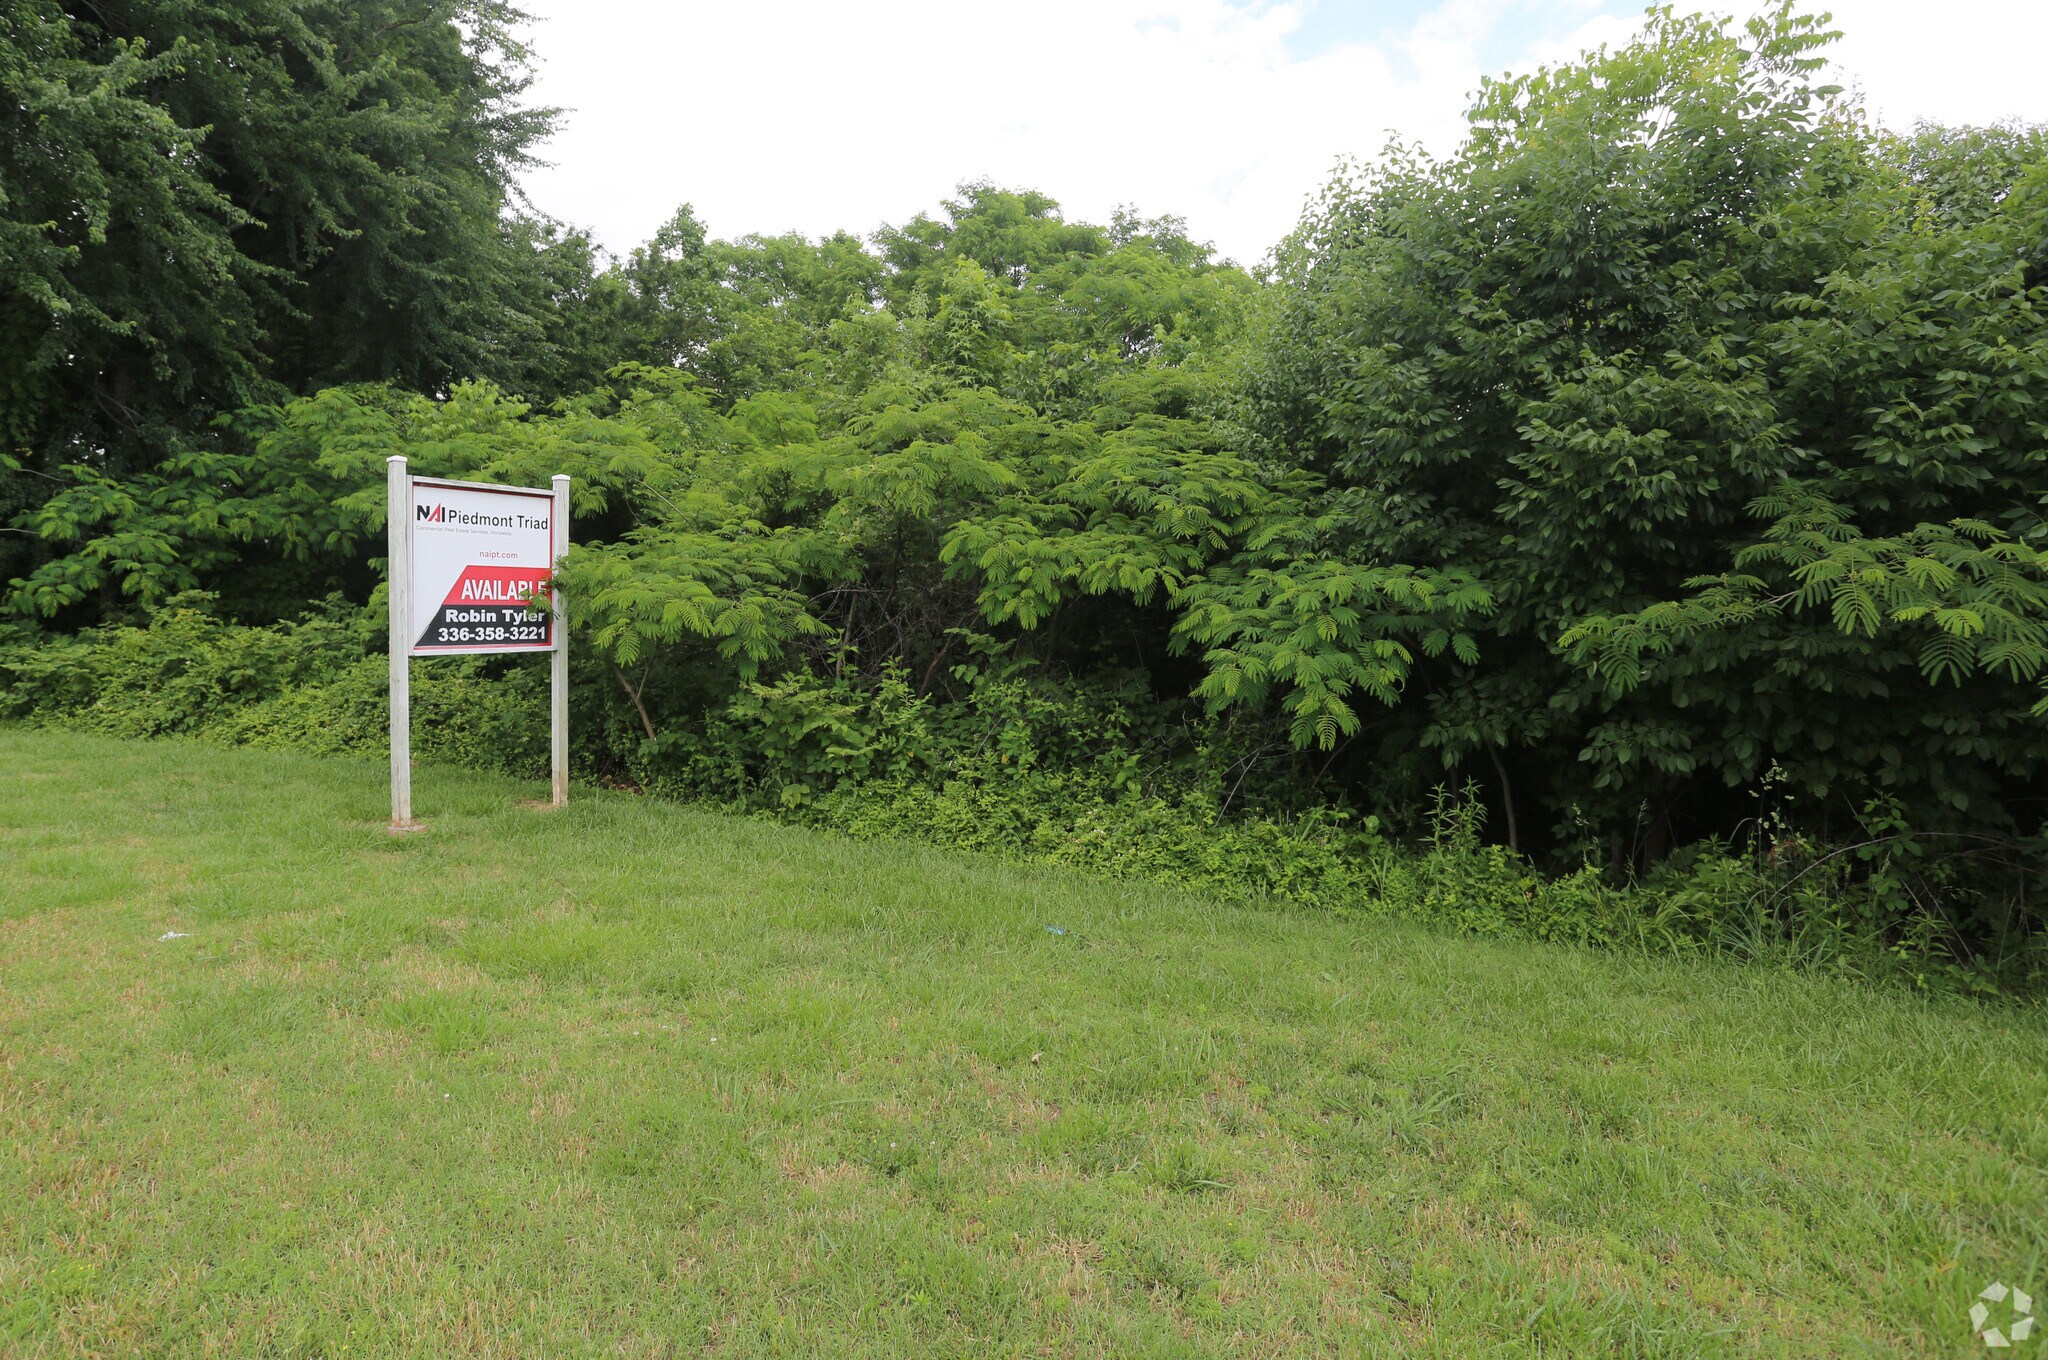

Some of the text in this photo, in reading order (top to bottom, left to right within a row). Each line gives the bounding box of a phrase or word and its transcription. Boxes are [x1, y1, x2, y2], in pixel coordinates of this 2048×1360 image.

[416, 502, 548, 531] NAI Piedmont Triad
[479, 550, 518, 560] naipt.com
[446, 609, 544, 625] Robin Tyler
[438, 626, 546, 642] 336-358-3221
